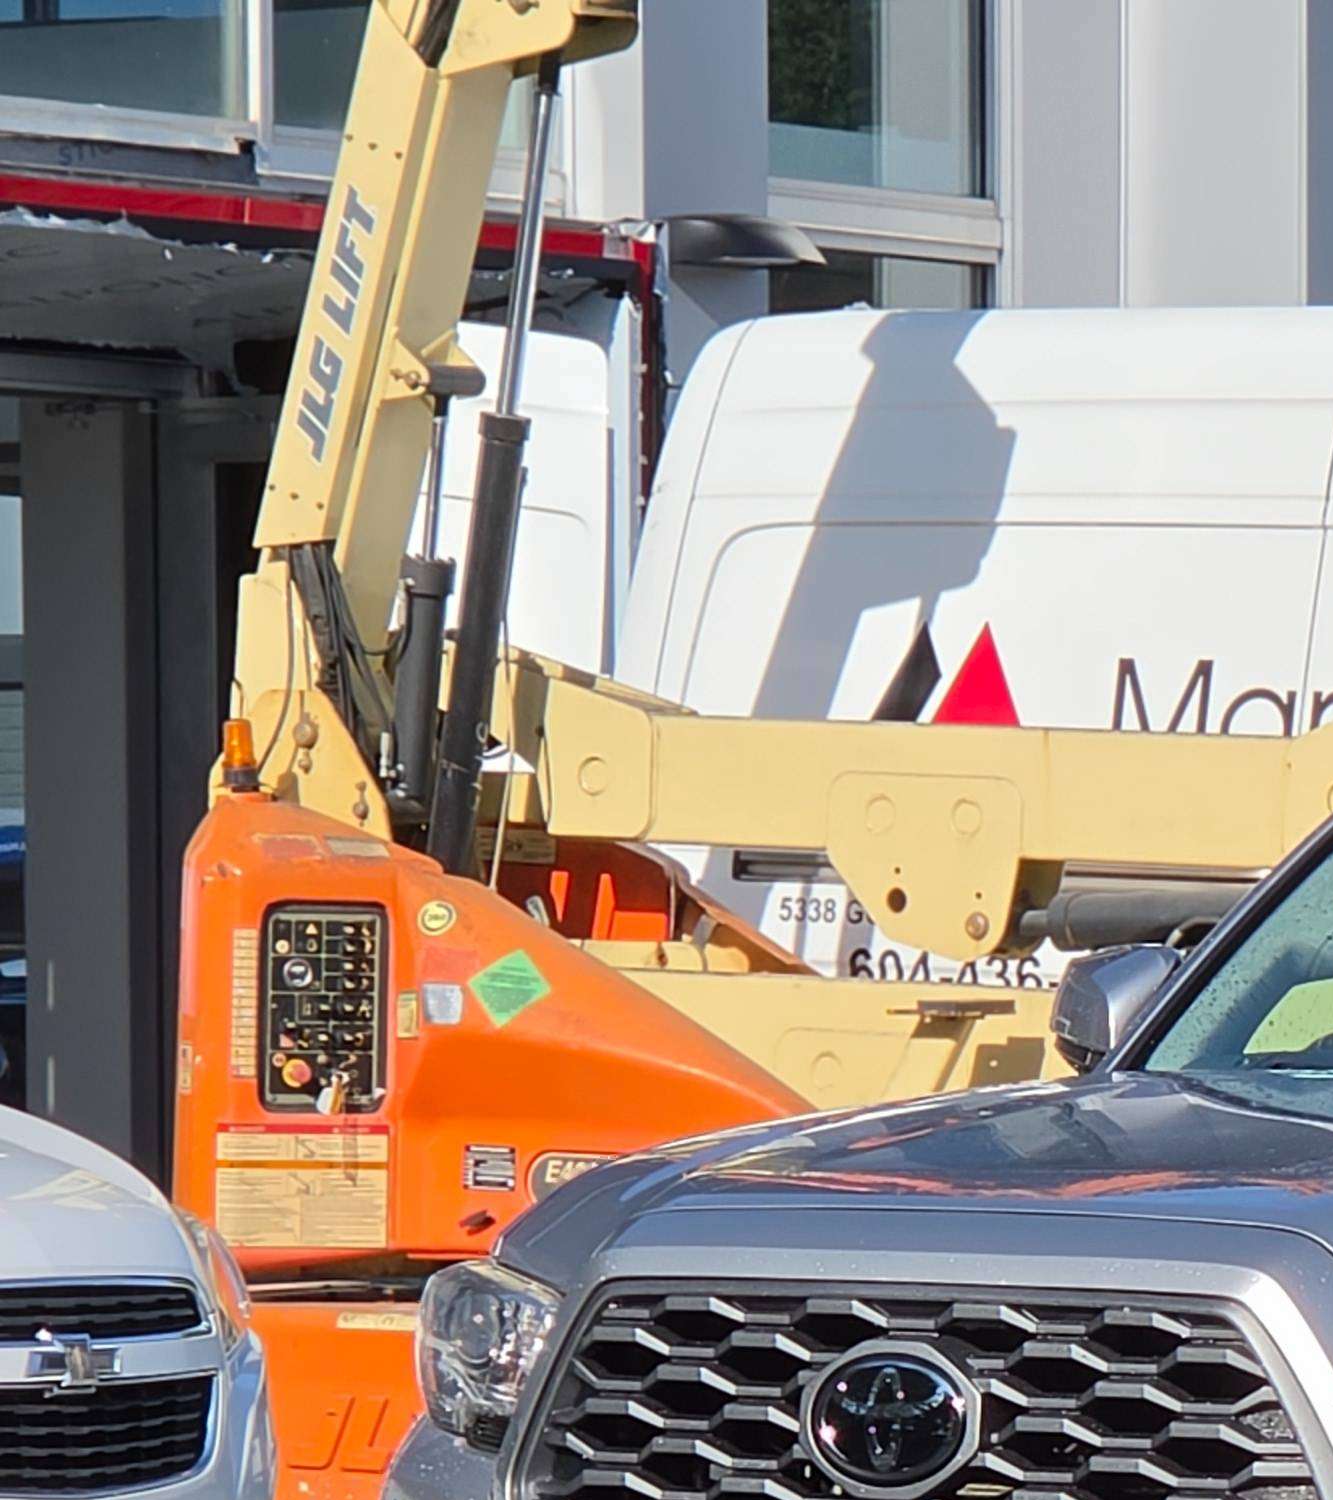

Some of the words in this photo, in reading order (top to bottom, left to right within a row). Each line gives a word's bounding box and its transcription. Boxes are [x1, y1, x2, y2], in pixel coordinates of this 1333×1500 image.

[296, 334, 343, 464] JLG
[321, 183, 376, 337] LIFT
[778, 896, 836, 923] 5338
